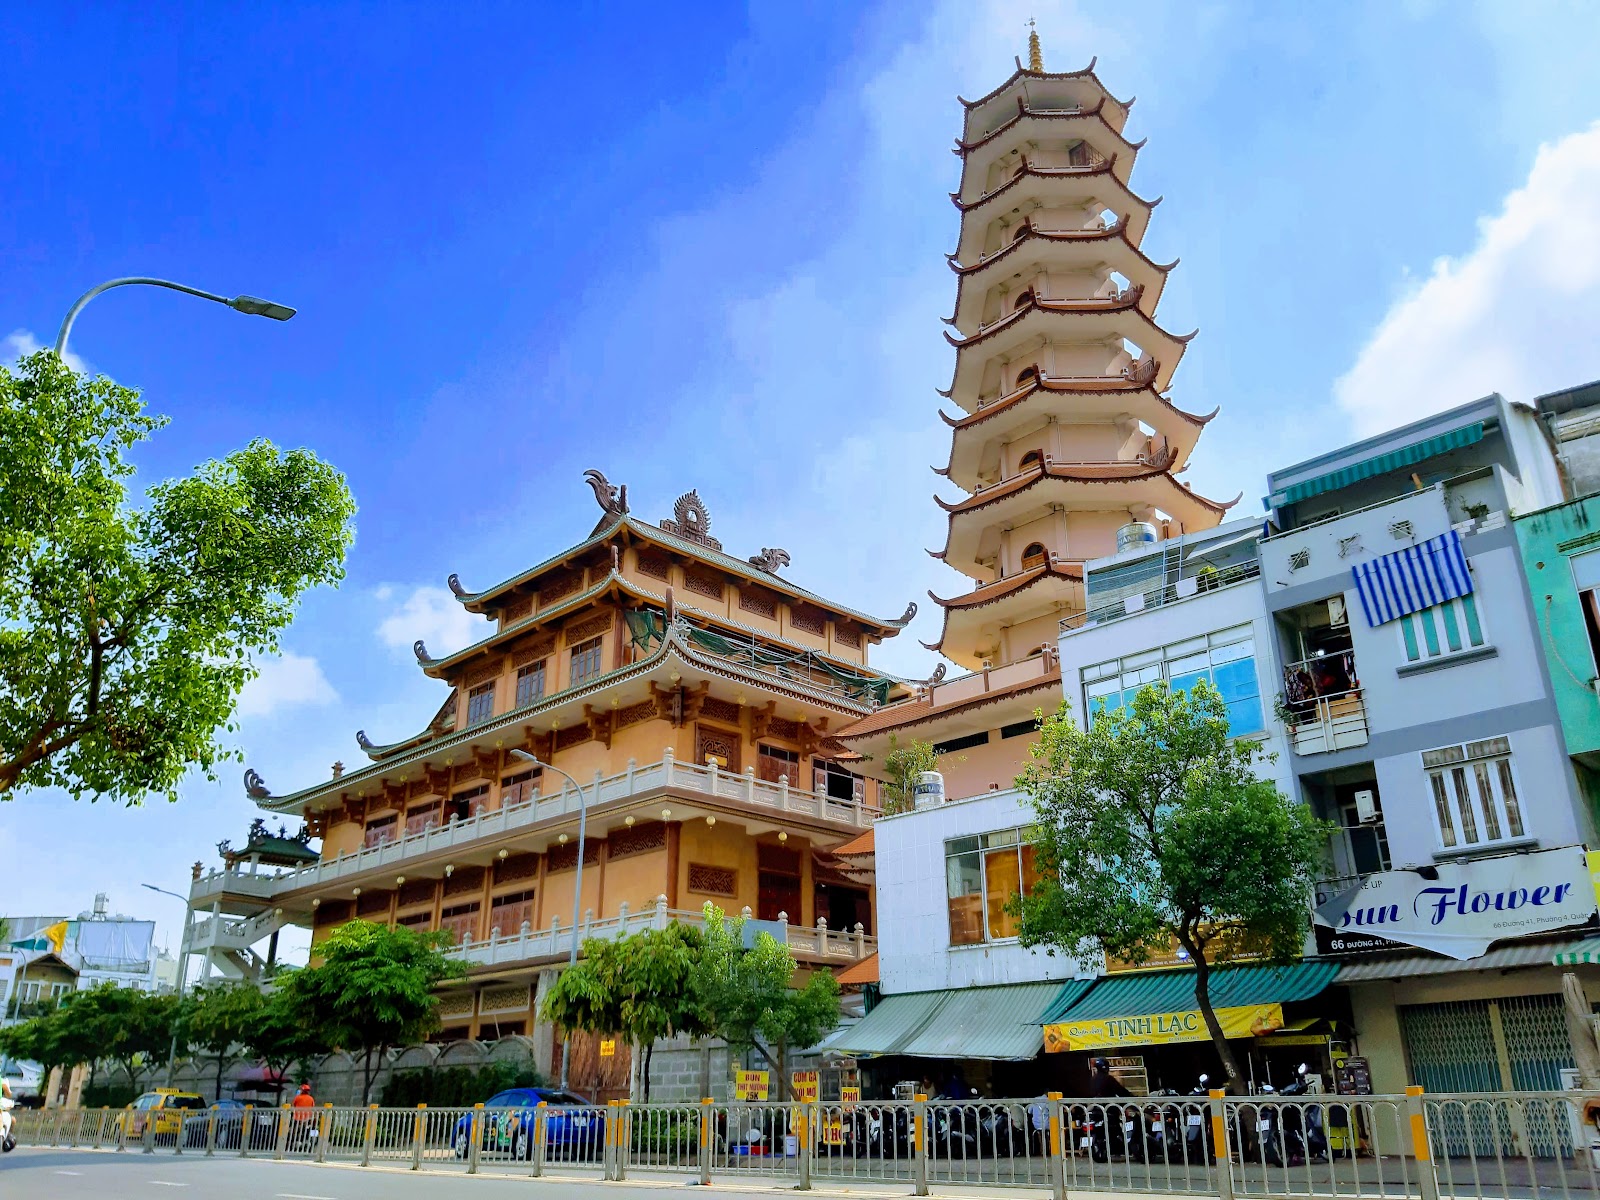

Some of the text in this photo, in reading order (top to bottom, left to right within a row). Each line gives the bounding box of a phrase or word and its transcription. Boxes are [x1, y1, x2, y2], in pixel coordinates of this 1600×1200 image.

[1370, 880, 1383, 889] UP
[1413, 882, 1574, 926] Flower
[1331, 940, 1344, 950] 66
[1104, 1017, 1152, 1040] TỊNH
[1156, 1013, 1198, 1036] LẠC
[1115, 1058, 1137, 1066] CHAY
